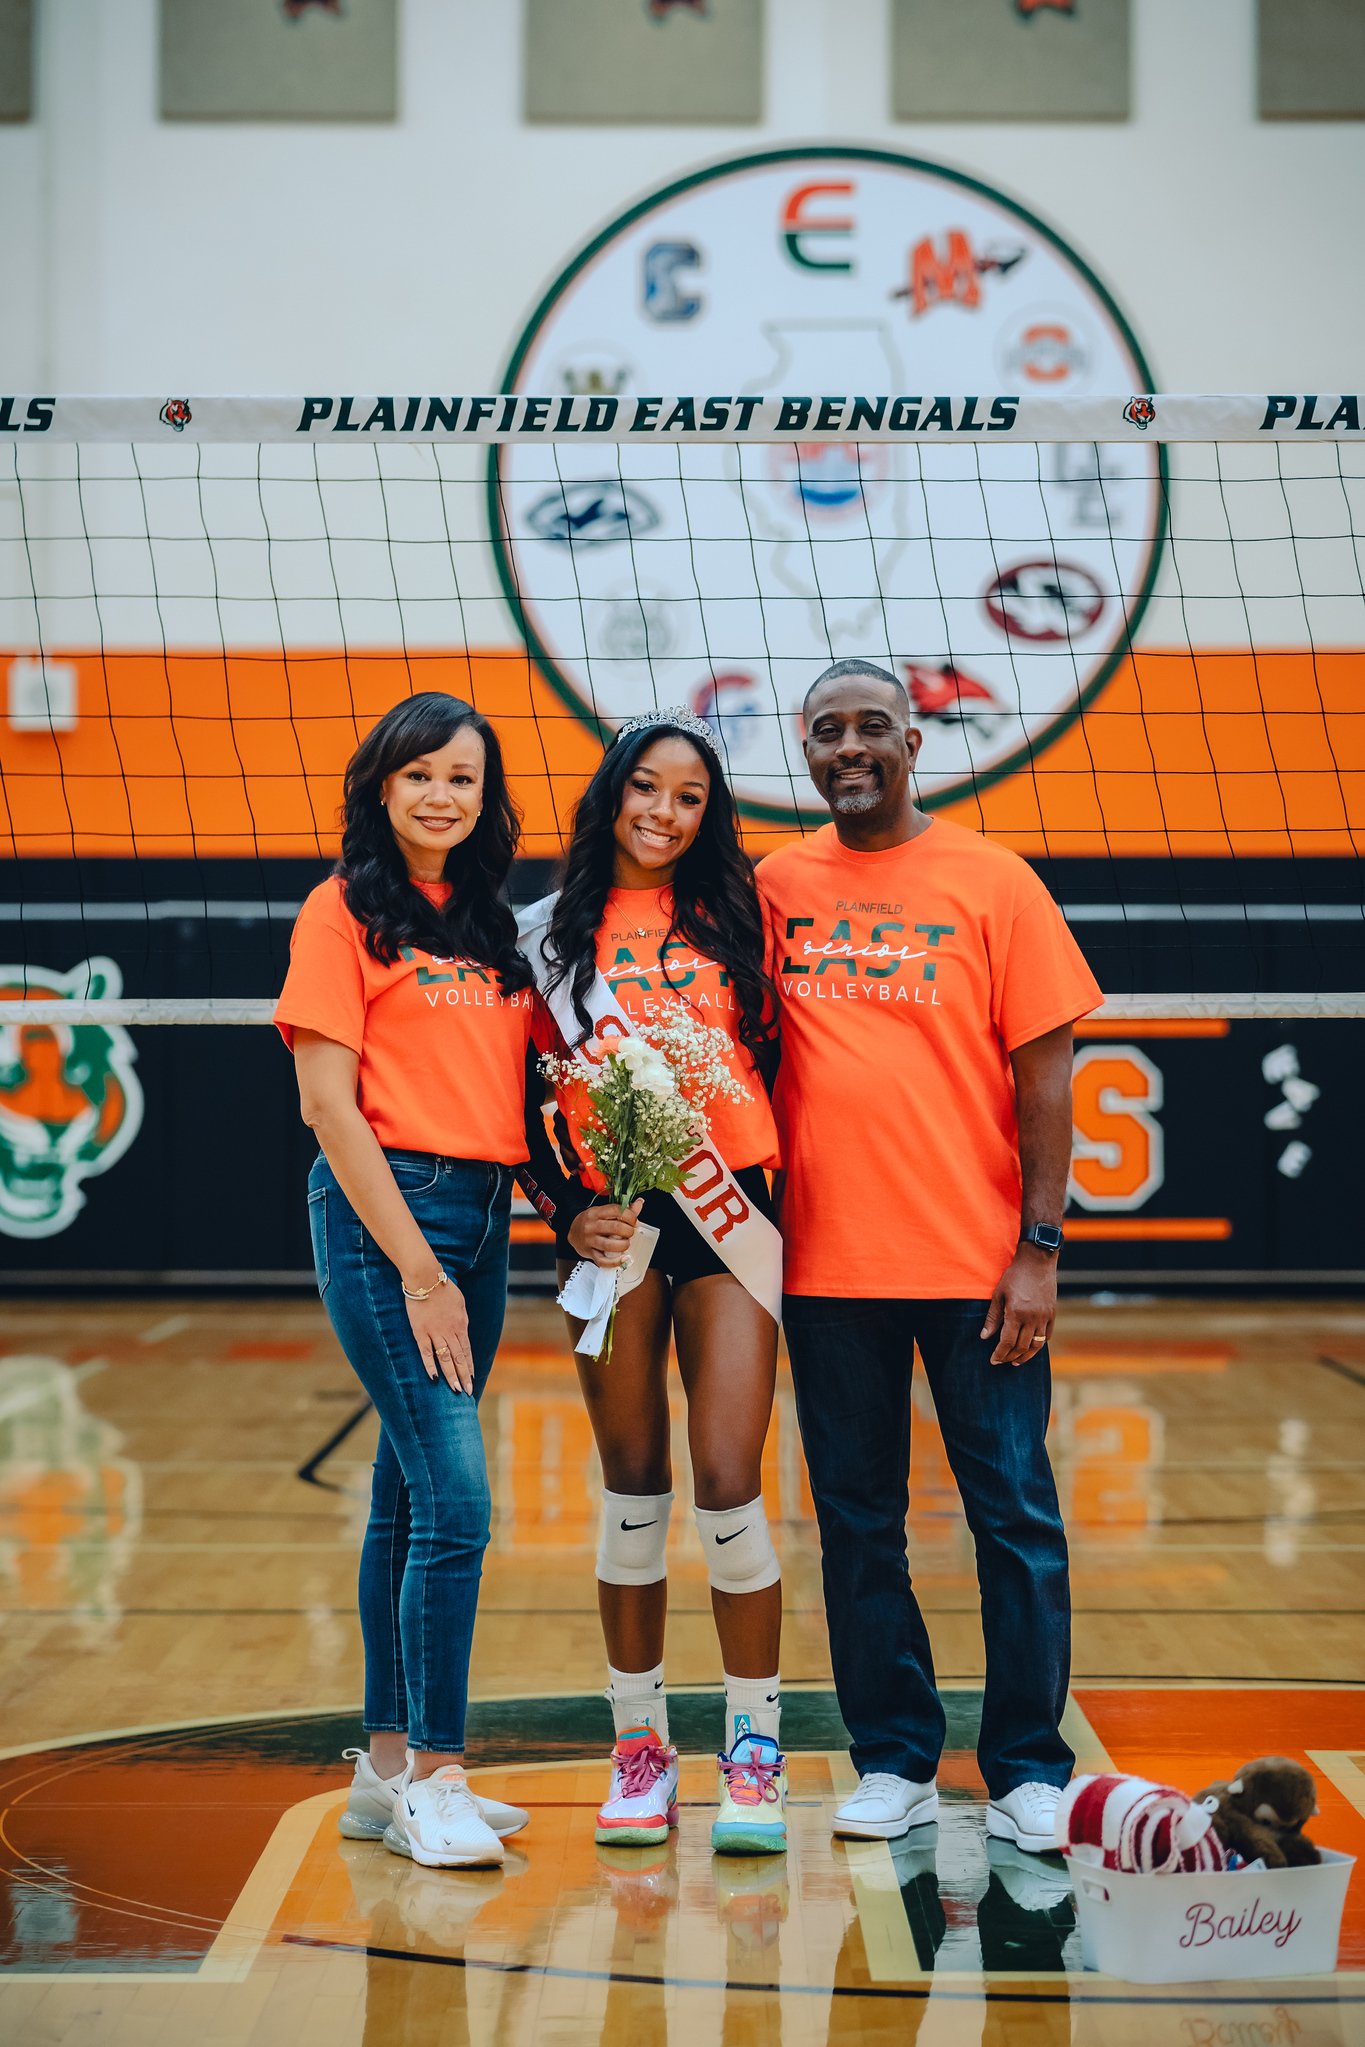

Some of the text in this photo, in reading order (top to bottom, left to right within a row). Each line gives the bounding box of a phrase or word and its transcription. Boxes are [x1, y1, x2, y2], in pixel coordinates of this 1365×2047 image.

[0, 397, 56, 431] LS
[296, 396, 1020, 432] PLAINFIELD EAST BENGALS
[836, 900, 903, 915] PLAINFIELD
[781, 917, 956, 981] EAST
[803, 940, 928, 960] senior
[602, 958, 718, 978] enior
[627, 992, 735, 1015] LEYBALL
[783, 980, 941, 1006] VOLLEYBALL
[1179, 1897, 1303, 1948] Bailey
